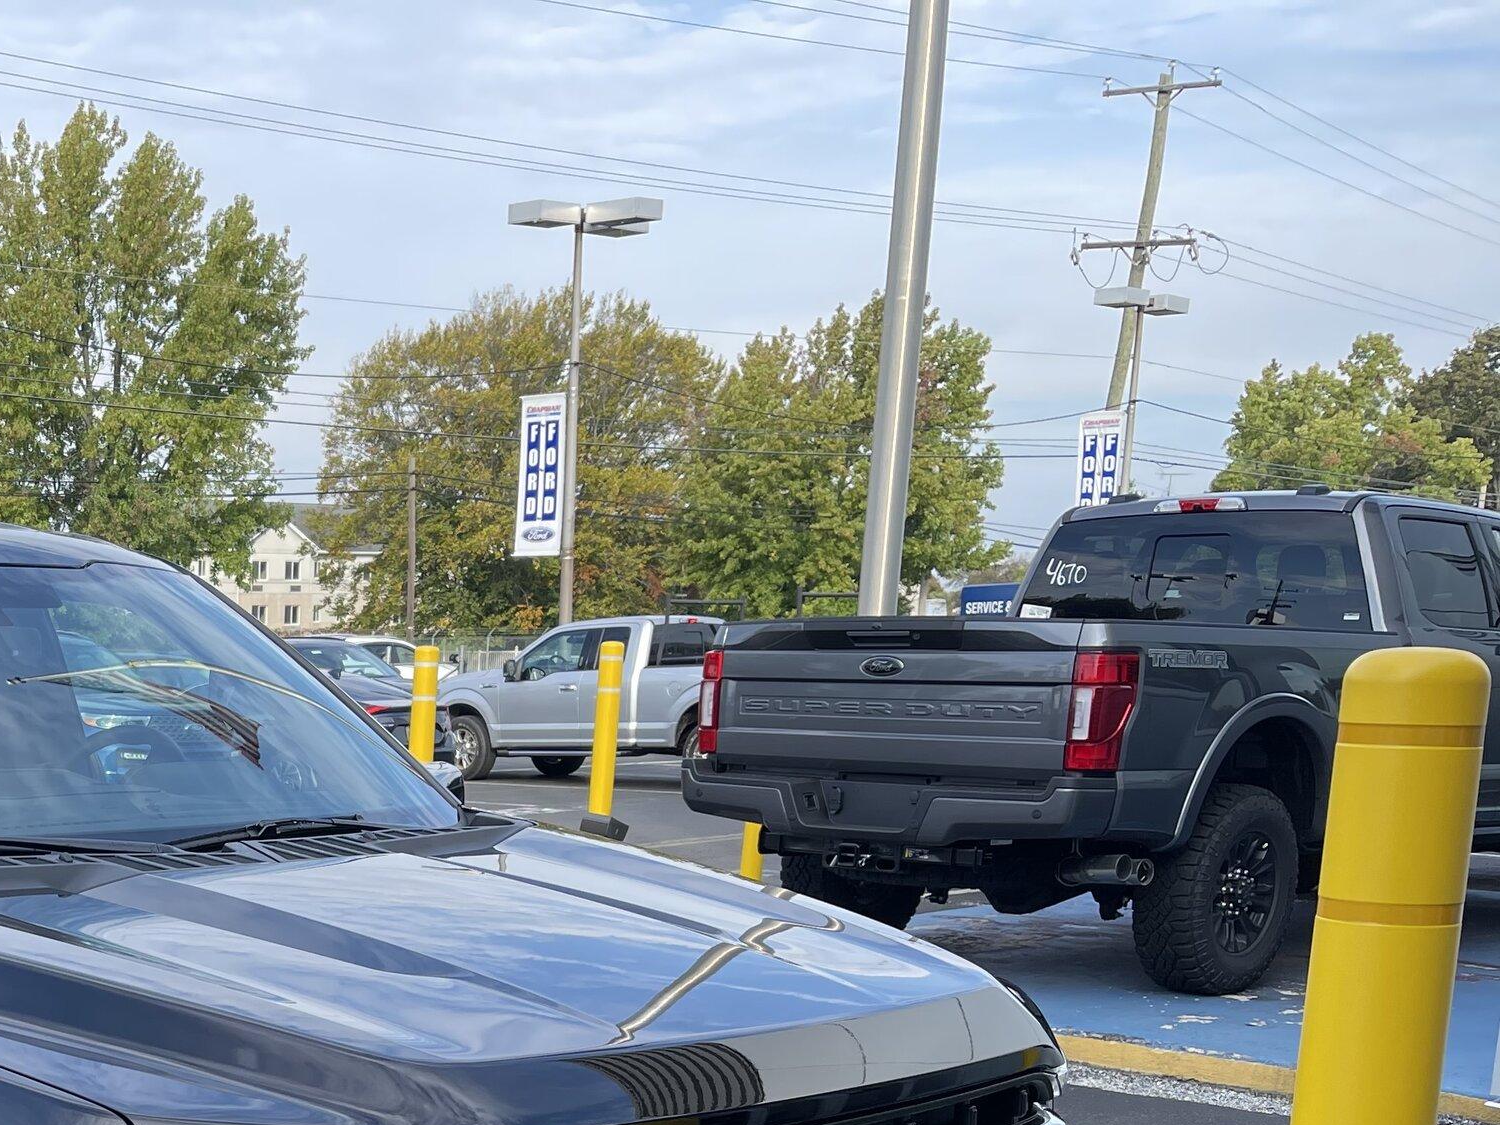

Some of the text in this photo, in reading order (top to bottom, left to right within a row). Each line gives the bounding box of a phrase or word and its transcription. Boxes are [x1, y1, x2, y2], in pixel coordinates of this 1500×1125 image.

[526, 424, 539, 515] FORD
[543, 422, 556, 514] FORD
[1046, 557, 1088, 586] 4670
[965, 600, 1004, 614] SERVICE
[1147, 648, 1229, 669] TREMOR
[743, 698, 1040, 719] SUPER DUTY
